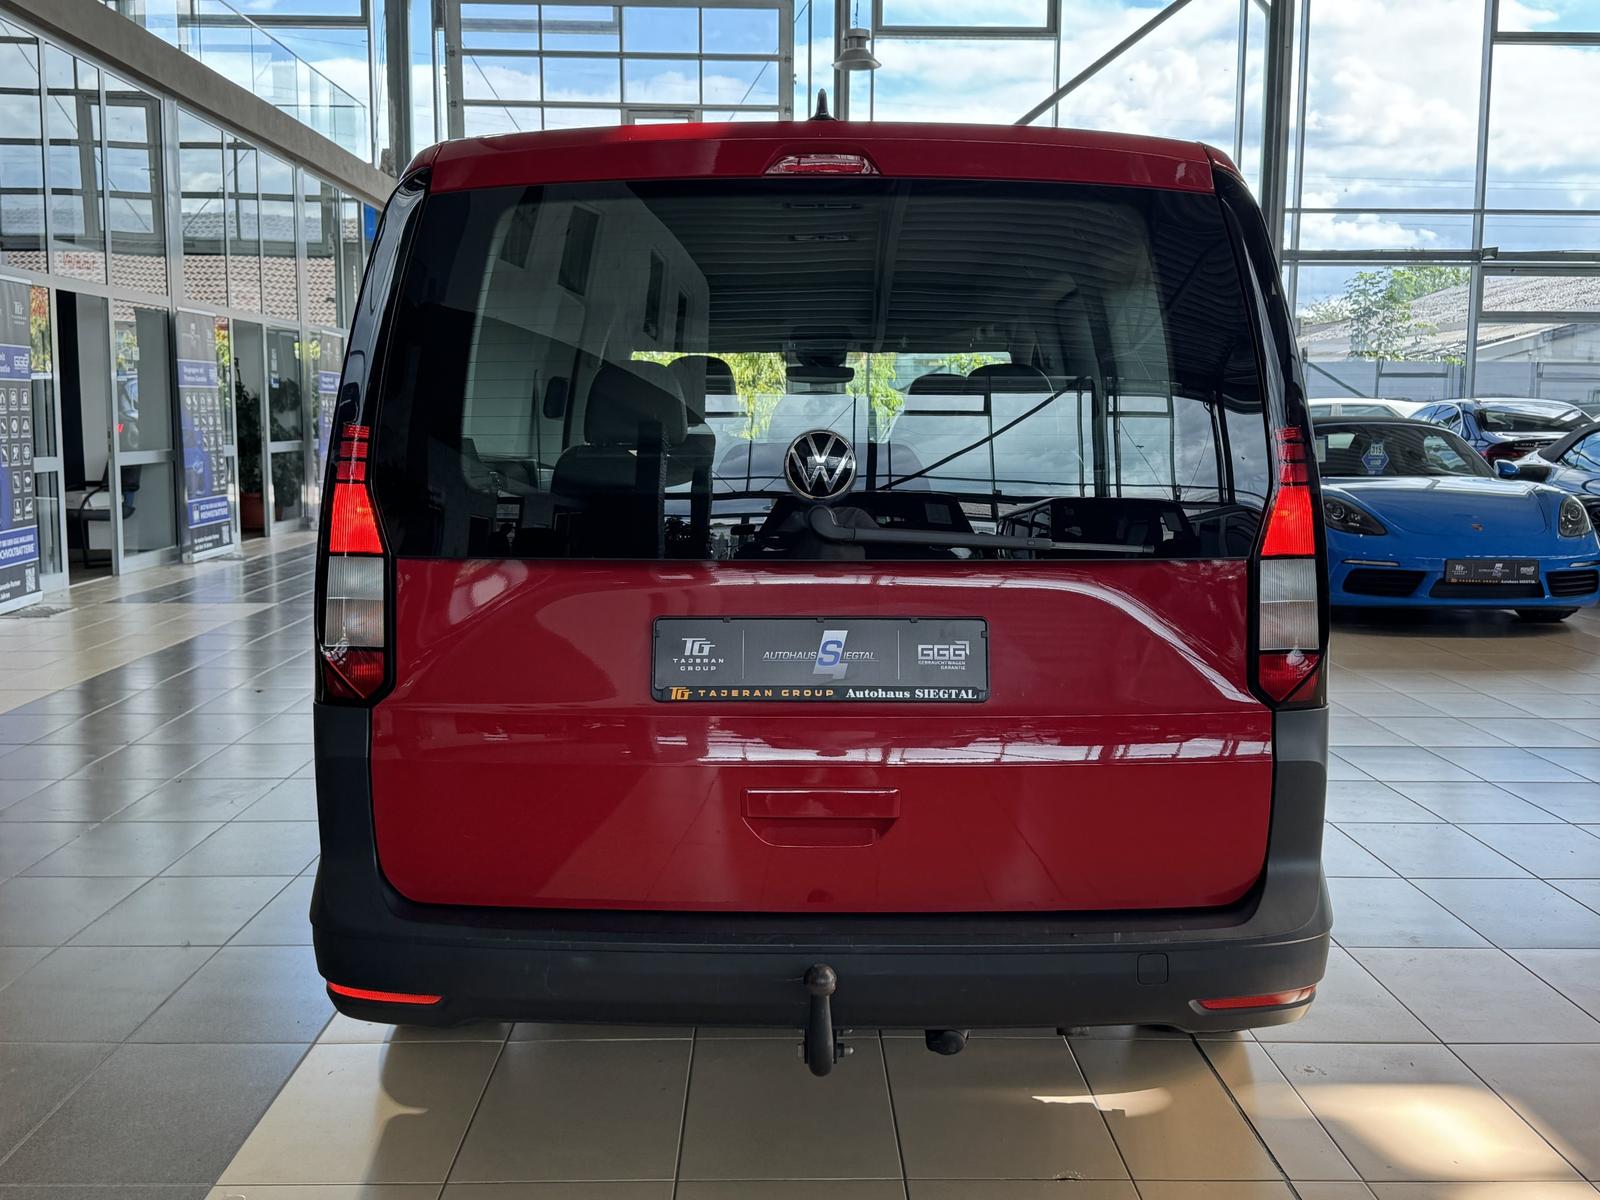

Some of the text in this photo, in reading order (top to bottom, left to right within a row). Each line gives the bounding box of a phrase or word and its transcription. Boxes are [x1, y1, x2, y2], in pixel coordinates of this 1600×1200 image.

[762, 650, 817, 660] AUTOHAUS
[917, 643, 967, 661] GGG
[698, 689, 773, 697] TAJERAN
[781, 689, 834, 697] GROUP
[845, 688, 977, 699] Autohaus SIEGTAL
